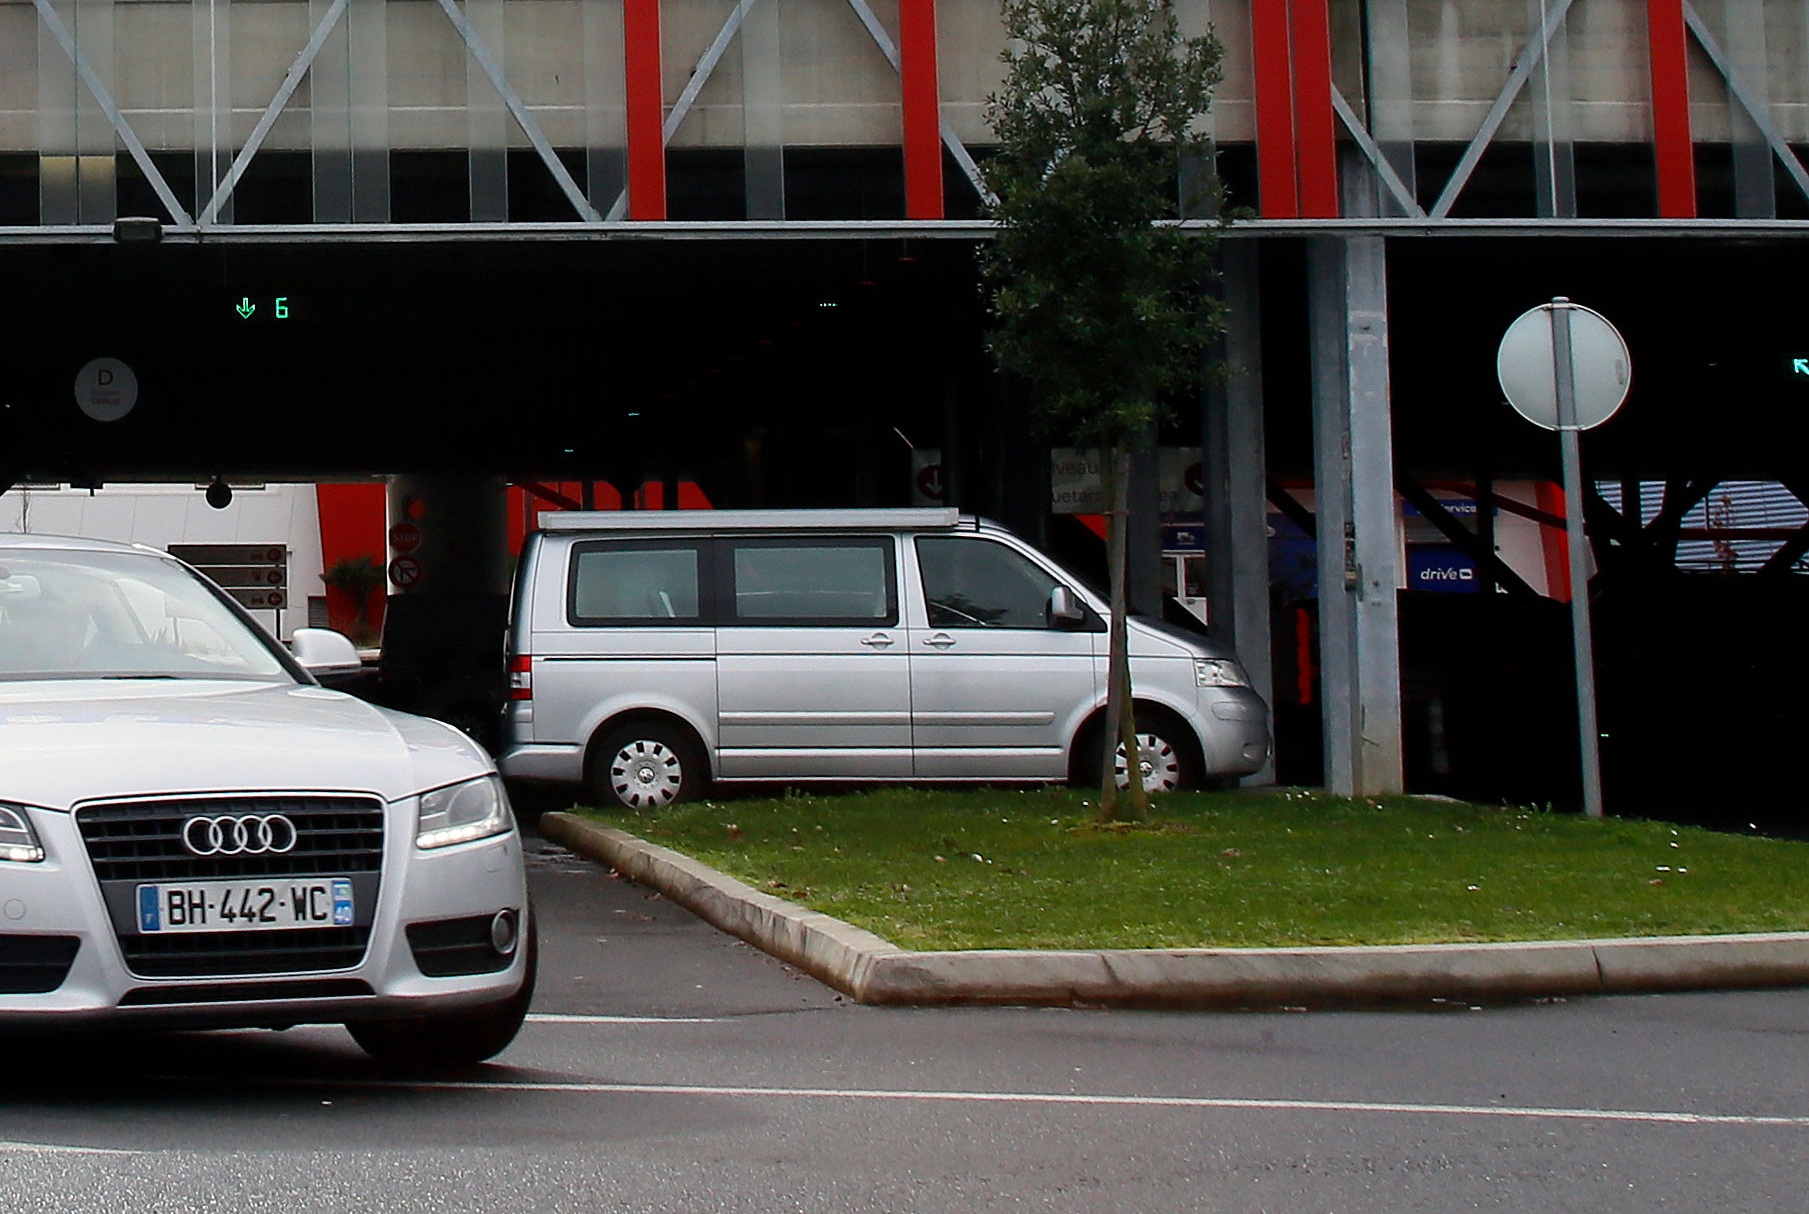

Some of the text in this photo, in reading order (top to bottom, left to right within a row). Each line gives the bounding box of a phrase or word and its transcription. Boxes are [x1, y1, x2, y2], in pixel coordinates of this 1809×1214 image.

[275, 297, 289, 319] 6
[98, 369, 114, 386] D
[392, 531, 418, 542] STOP
[1419, 566, 1458, 580] drive
